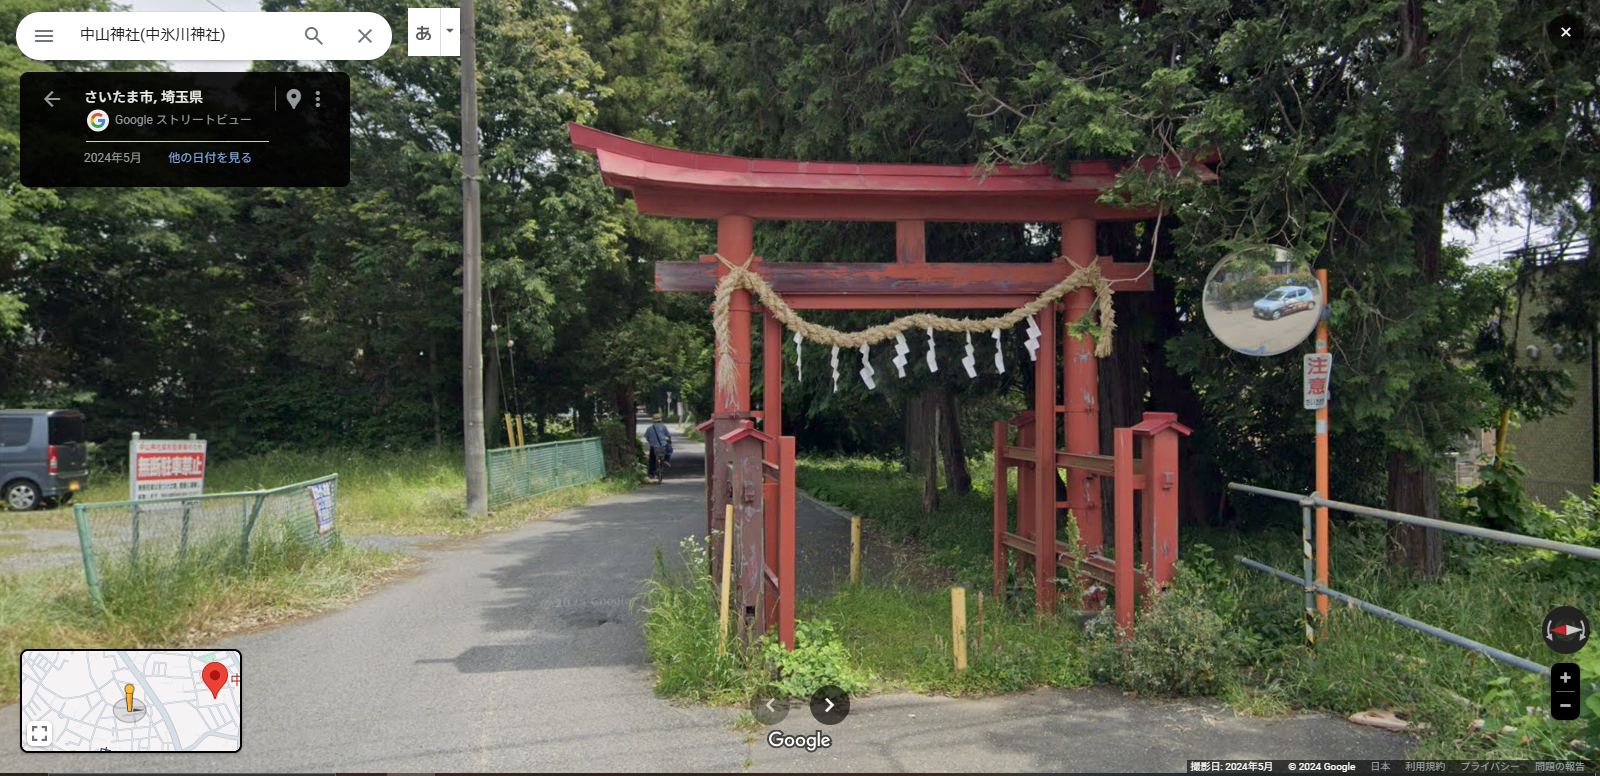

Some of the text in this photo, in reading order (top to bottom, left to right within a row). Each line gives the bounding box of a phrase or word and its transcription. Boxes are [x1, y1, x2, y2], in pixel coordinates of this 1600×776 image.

[1307, 356, 1328, 395] 注意
[138, 455, 203, 479] 無断駐車禁止
